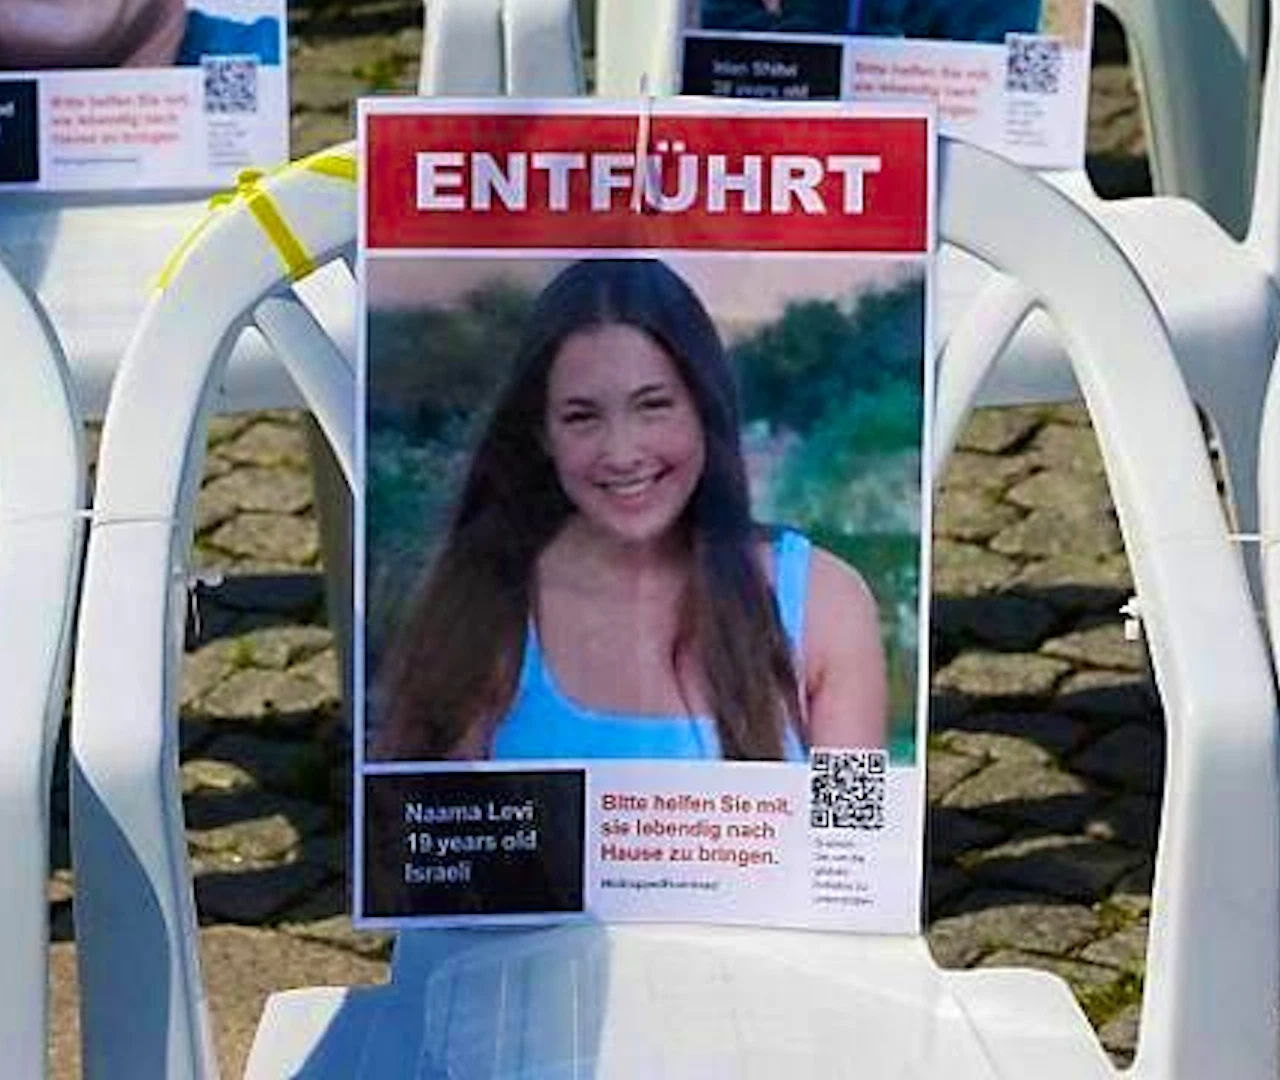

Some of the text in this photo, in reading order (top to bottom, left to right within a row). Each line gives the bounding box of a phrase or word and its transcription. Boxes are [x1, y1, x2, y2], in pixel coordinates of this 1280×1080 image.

[415, 142, 881, 215] ENTFÜHRT
[405, 800, 534, 823] Naama Levi
[602, 794, 647, 811] Bitte
[654, 795, 715, 812] helfen
[721, 795, 751, 813] Sie
[601, 820, 775, 840] sie lebendig nach
[407, 830, 537, 857] 19 years old
[601, 845, 779, 866] Hause zu bringen.
[405, 860, 471, 883] Israeli
